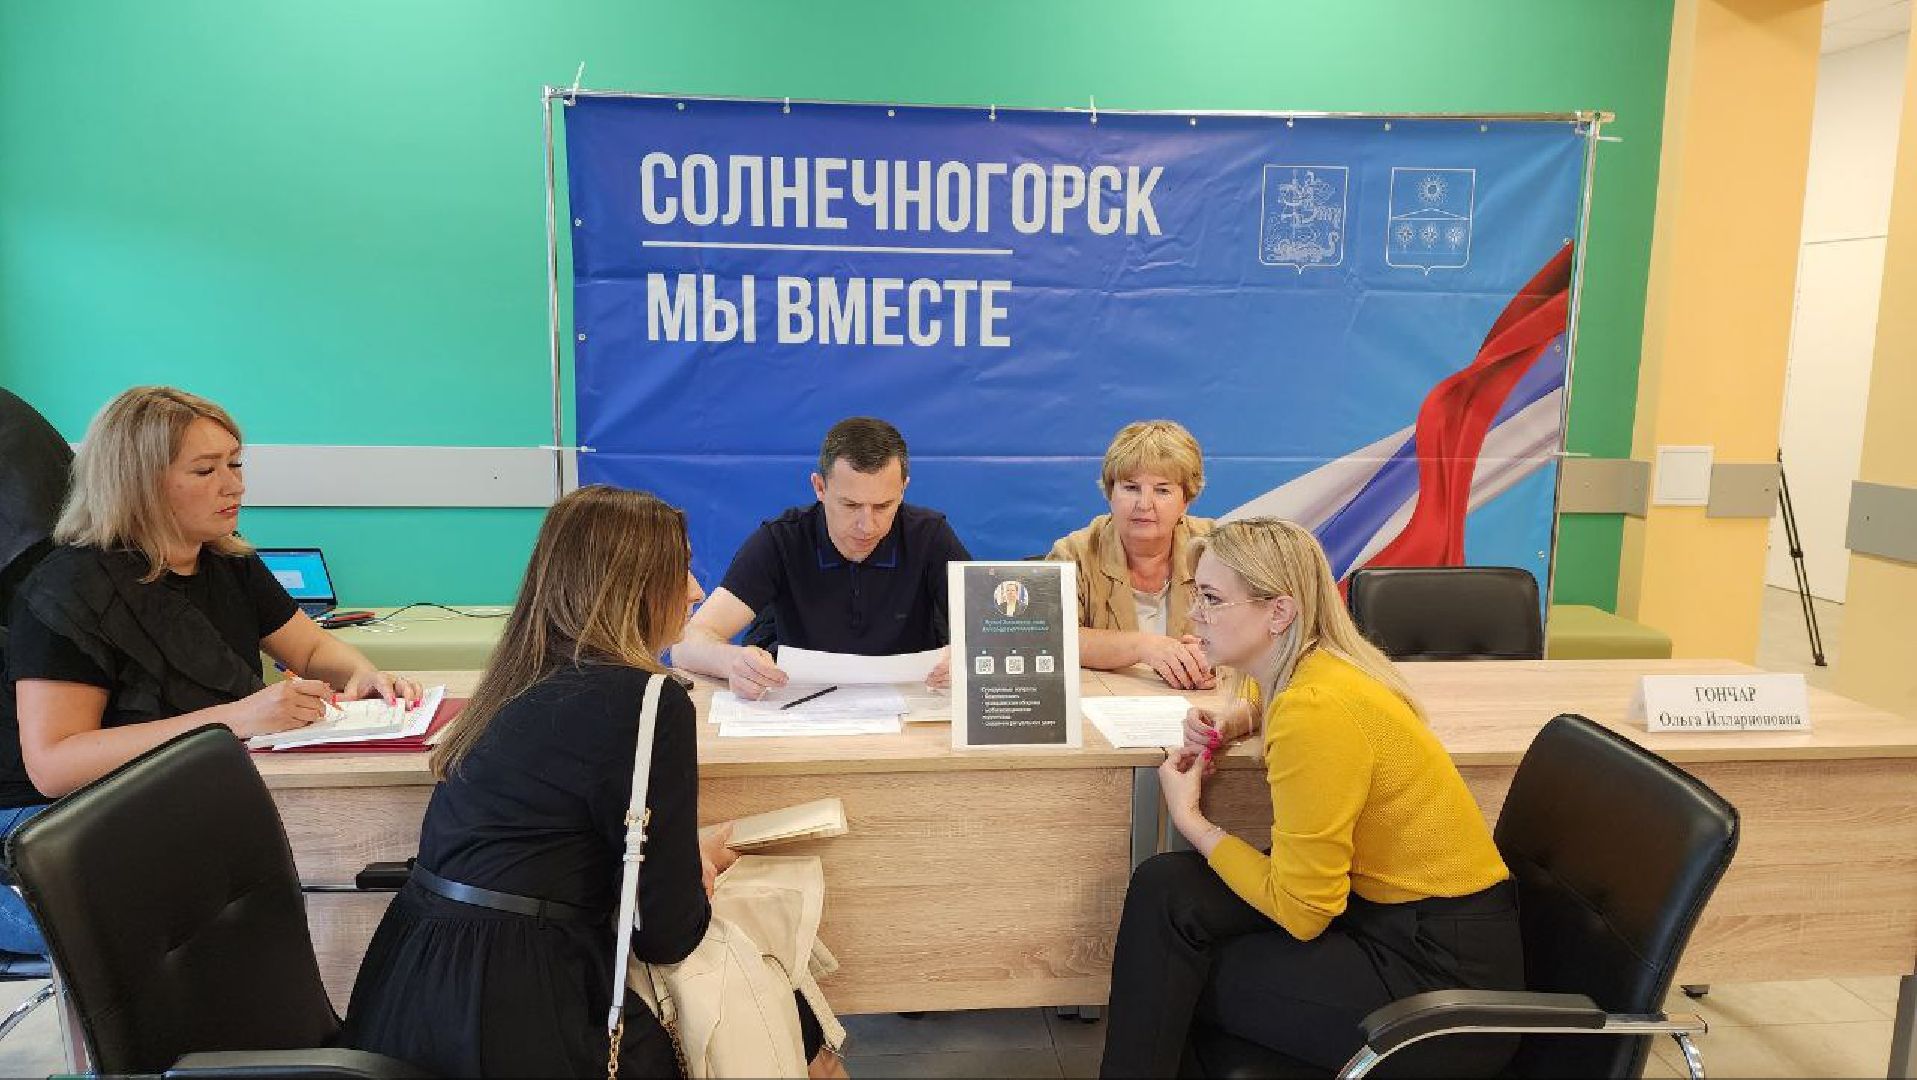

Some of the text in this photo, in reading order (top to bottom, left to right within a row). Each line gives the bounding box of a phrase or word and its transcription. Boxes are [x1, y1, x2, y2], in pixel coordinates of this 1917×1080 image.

[642, 152, 1163, 236] СОЛНЕЧНОГОРСК
[647, 273, 1012, 348] МЫ ВМЕСТЕ
[1695, 686, 1757, 702] ГОНЧАР
[1659, 711, 1801, 729] Ольга Илларионовна
